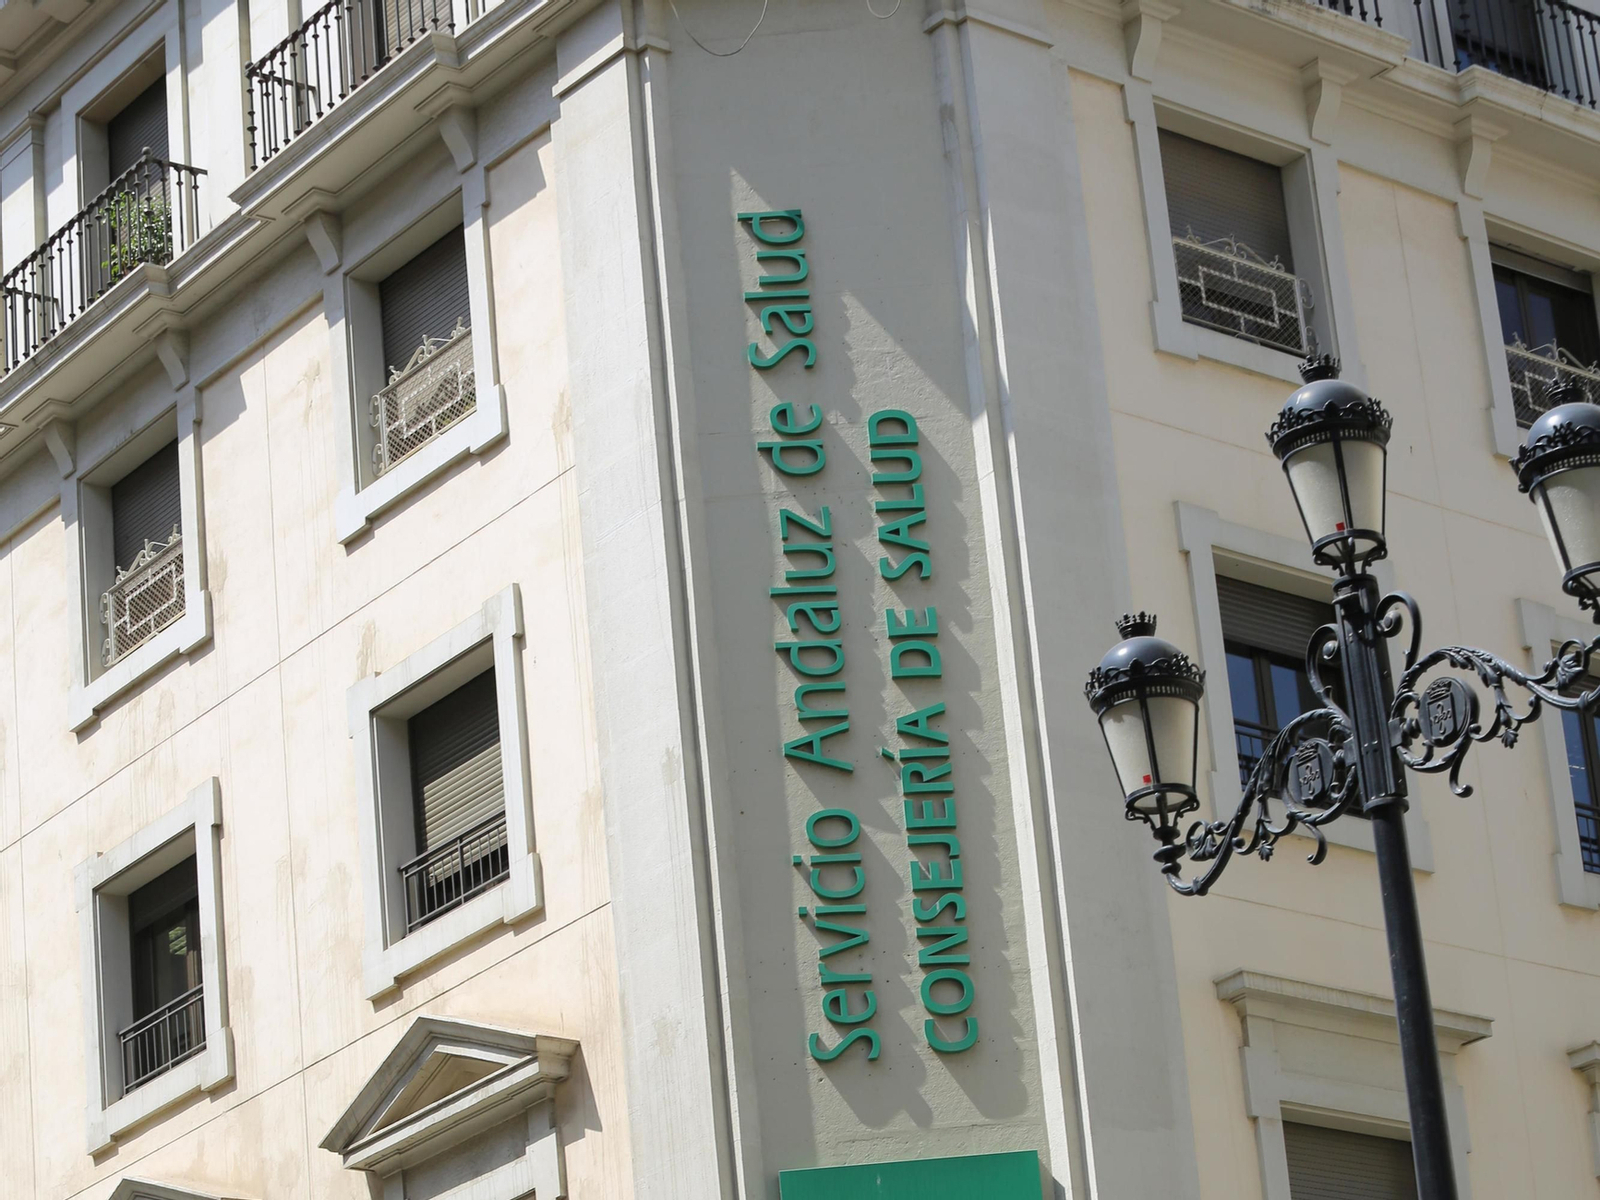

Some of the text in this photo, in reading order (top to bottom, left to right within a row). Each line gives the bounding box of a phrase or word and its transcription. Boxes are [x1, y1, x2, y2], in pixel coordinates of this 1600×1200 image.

[737, 209, 880, 1062] Servicio Andaluz de Salud
[867, 409, 978, 1055] CONSEJERÍA DE SALUD
